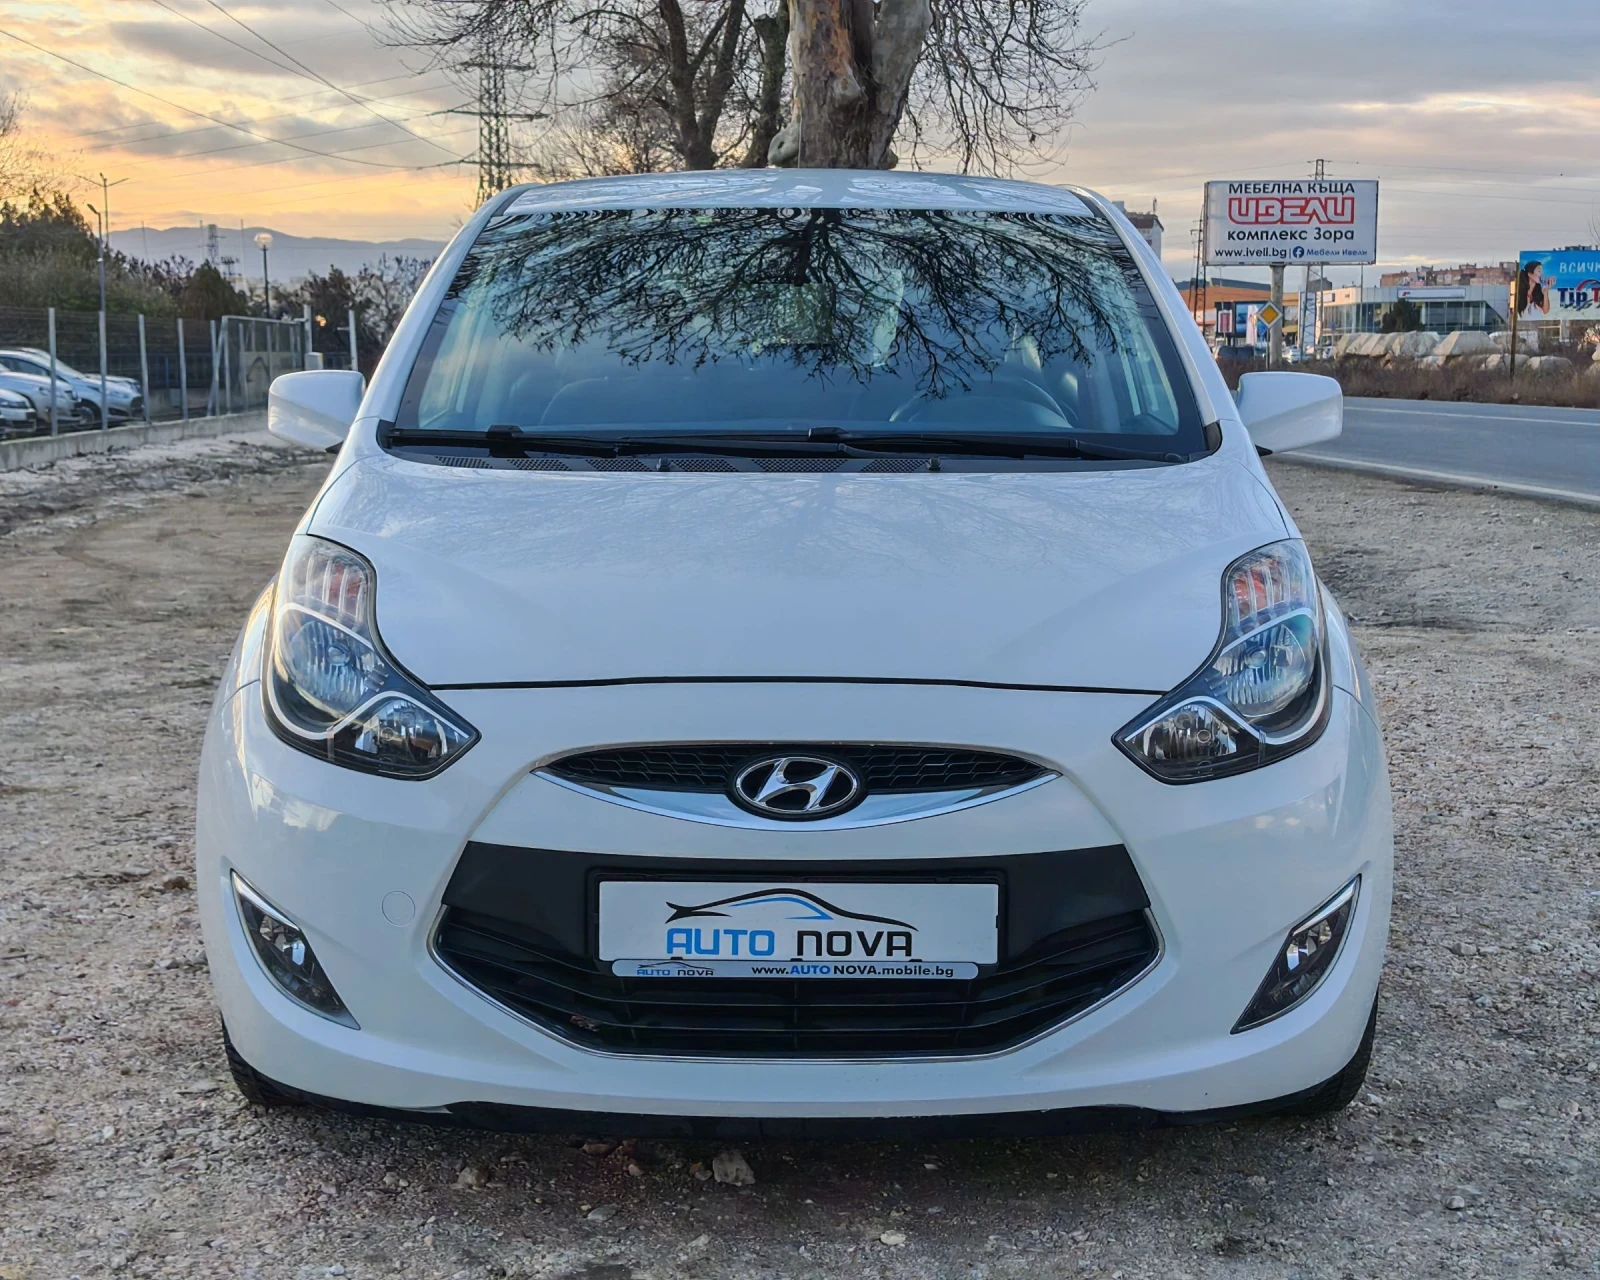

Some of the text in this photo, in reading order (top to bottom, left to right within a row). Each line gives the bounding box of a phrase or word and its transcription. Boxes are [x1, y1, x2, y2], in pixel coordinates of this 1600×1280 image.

[1228, 182, 1355, 195] МЕБЕЛНА КЪЩА
[1227, 227, 1355, 243] комплекс Зора
[666, 927, 913, 958] AUTO NOVA
[636, 968, 671, 976] AUTO
[834, 964, 954, 978] NOVA.mobile.bg
